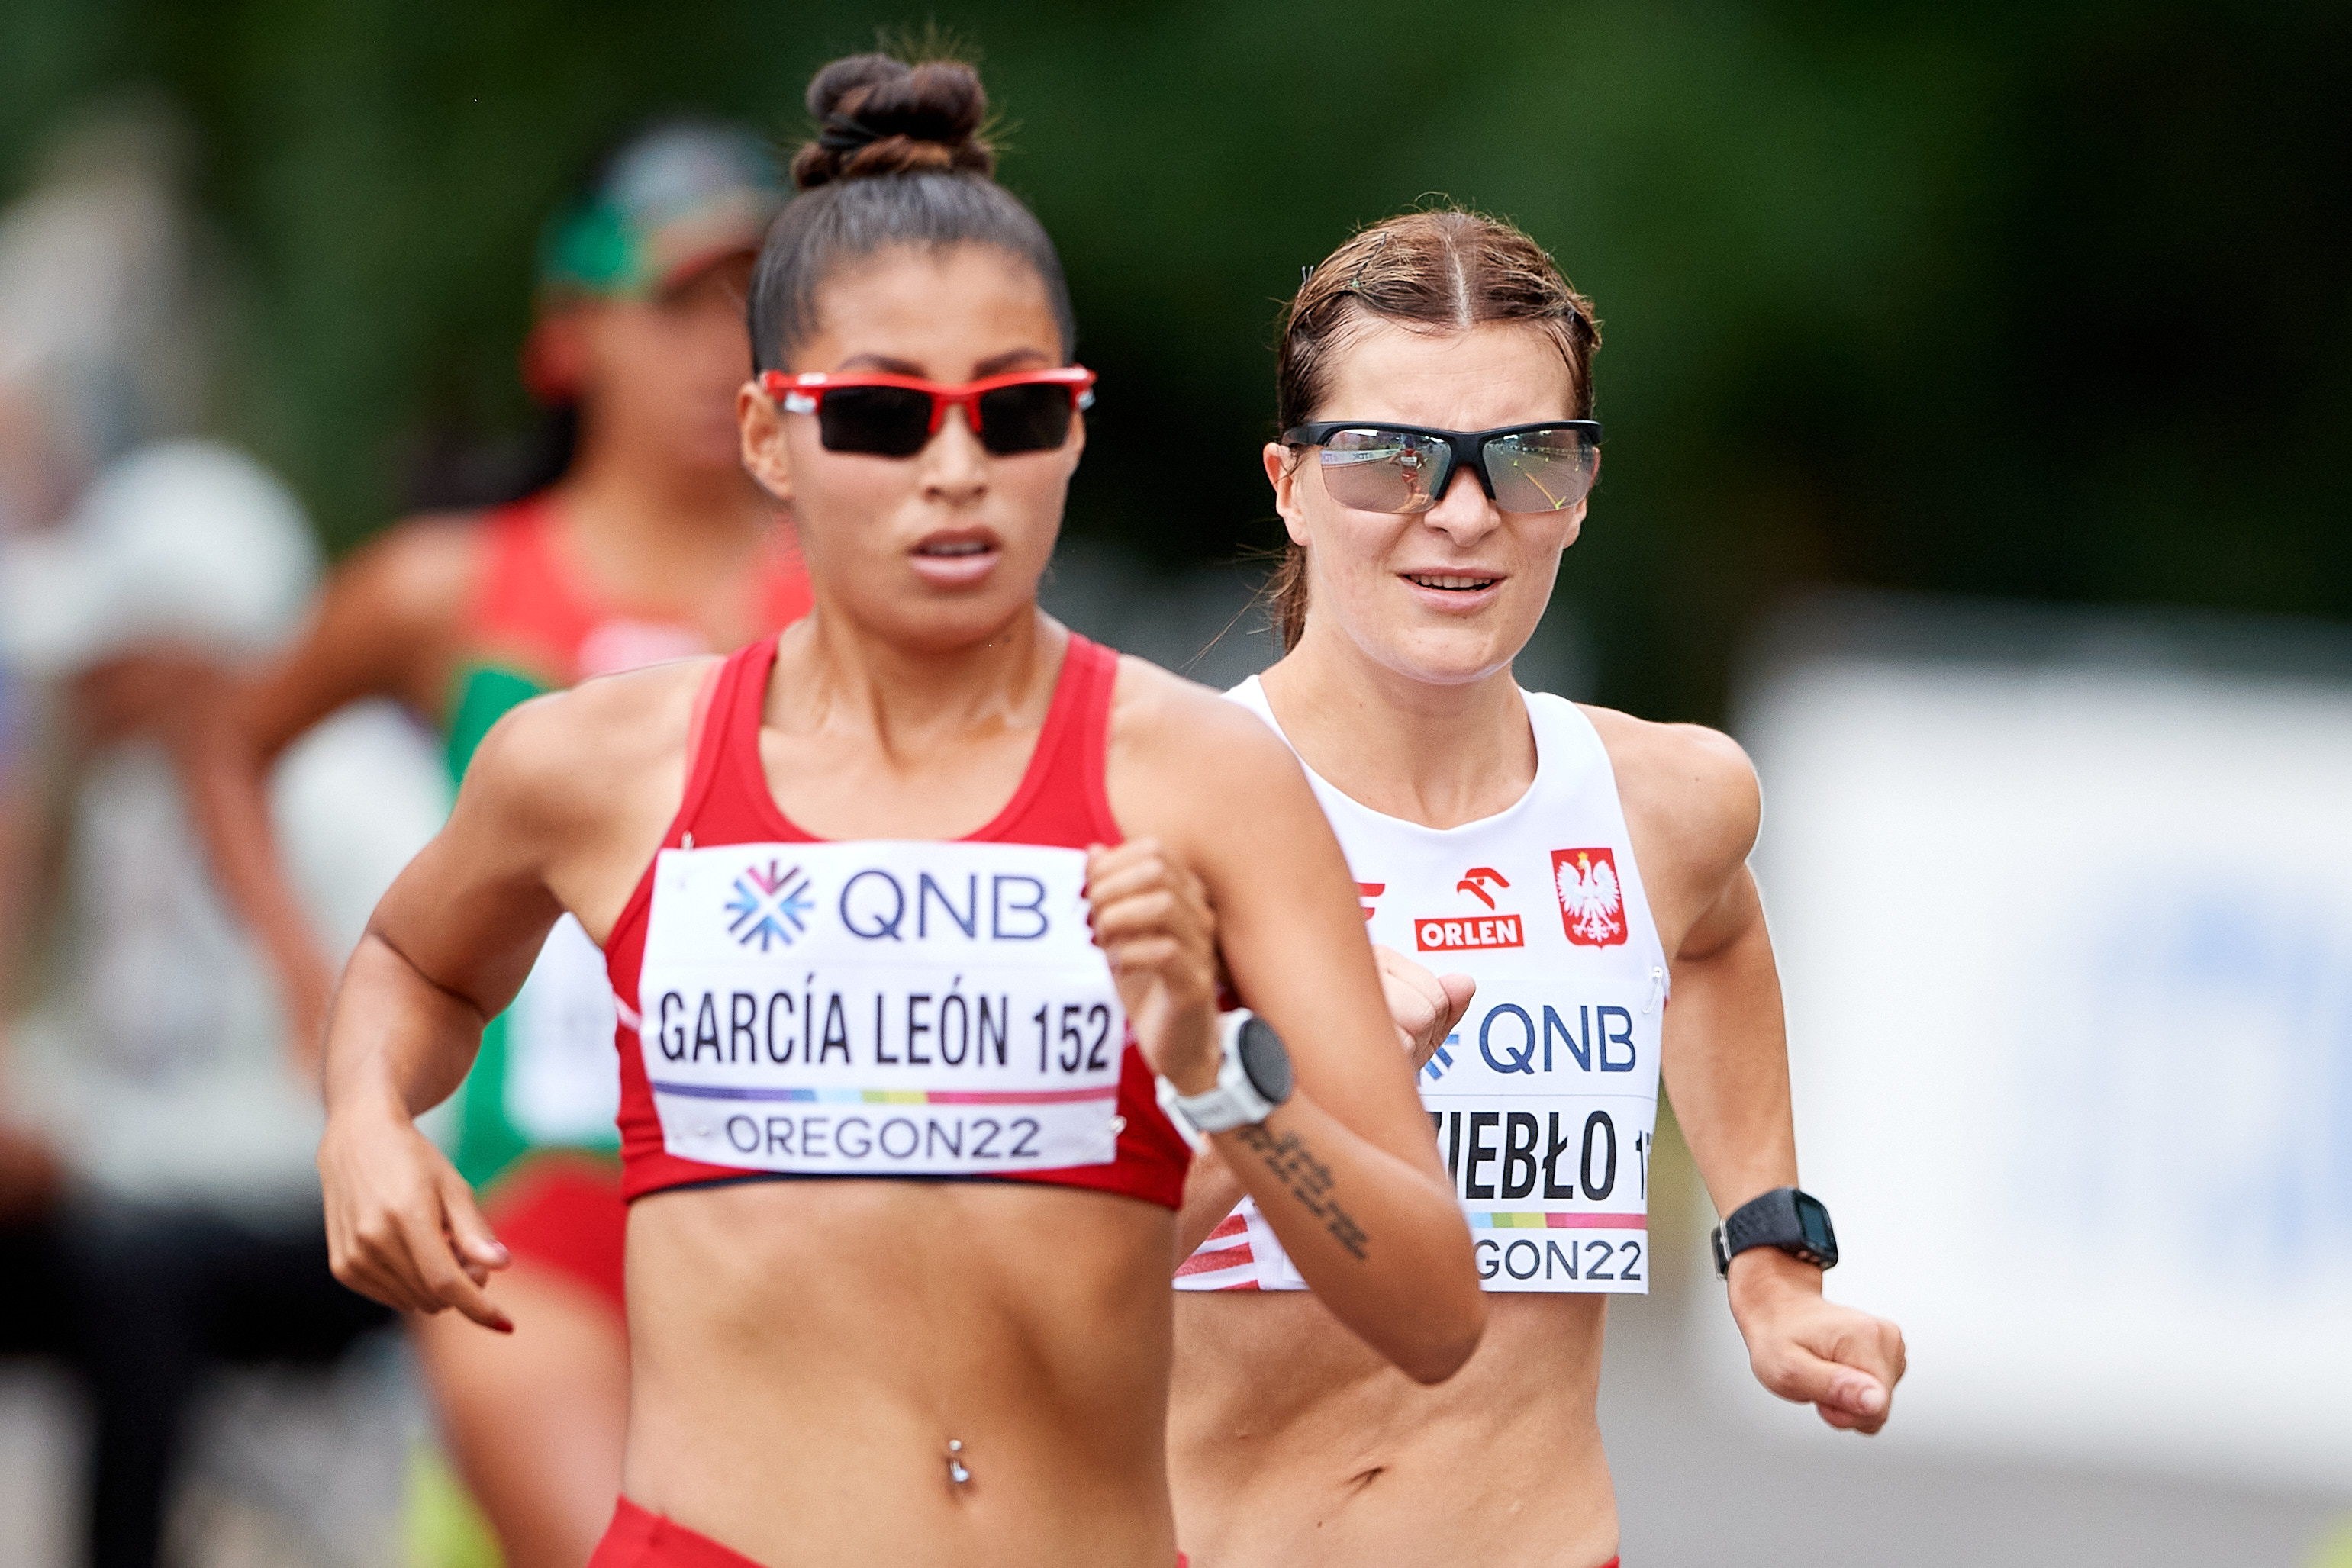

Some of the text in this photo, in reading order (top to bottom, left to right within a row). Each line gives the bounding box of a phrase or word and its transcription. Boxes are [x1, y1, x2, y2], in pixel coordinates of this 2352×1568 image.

[840, 871, 1048, 940] QNB
[1421, 919, 1518, 947] ORLEN
[659, 974, 1111, 1074] GARCÍA LEÓN 152
[1479, 1003, 1636, 1074] QNB
[726, 1116, 1039, 1159] OREGON22
[1429, 1110, 1616, 1201] IEBŁO
[1474, 1239, 1642, 1280] GON22
